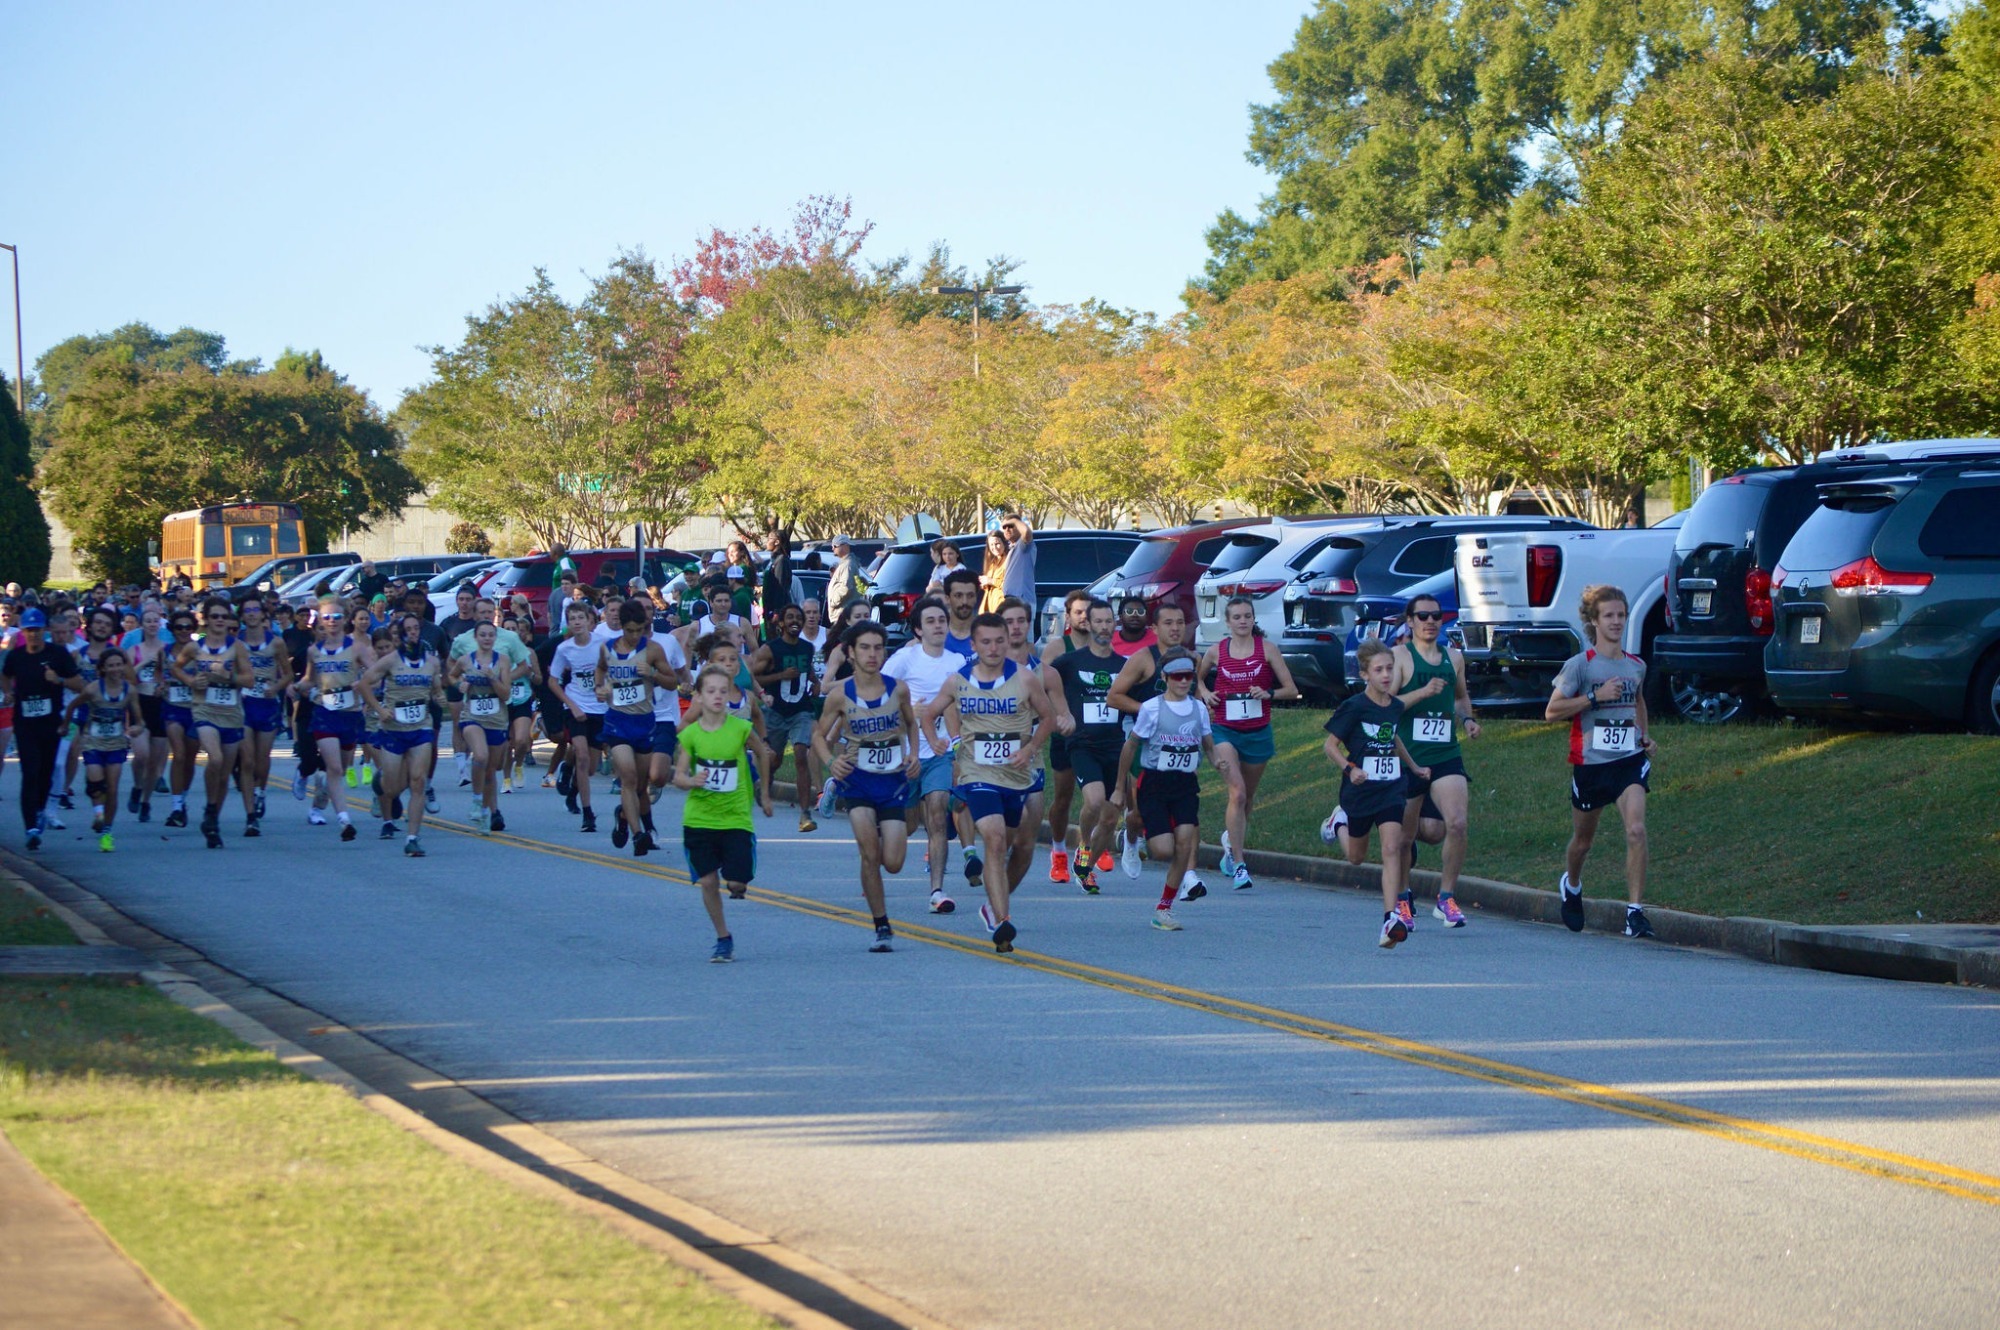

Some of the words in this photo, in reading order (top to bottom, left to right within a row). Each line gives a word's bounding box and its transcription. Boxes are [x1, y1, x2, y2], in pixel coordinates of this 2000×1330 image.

[333, 693, 345, 706] 24
[618, 687, 638, 701] 323
[403, 706, 421, 720] 153
[476, 700, 494, 712] 300
[961, 697, 1018, 715] BROOME
[1096, 704, 1110, 718] 14
[1242, 700, 1247, 714] 1
[850, 711, 900, 735] BROOME
[1422, 719, 1445, 736] 272
[1603, 727, 1628, 745] 357
[868, 748, 892, 765] 200
[984, 741, 1010, 759] 228
[1167, 753, 1192, 768] 379
[1374, 758, 1394, 775] 155
